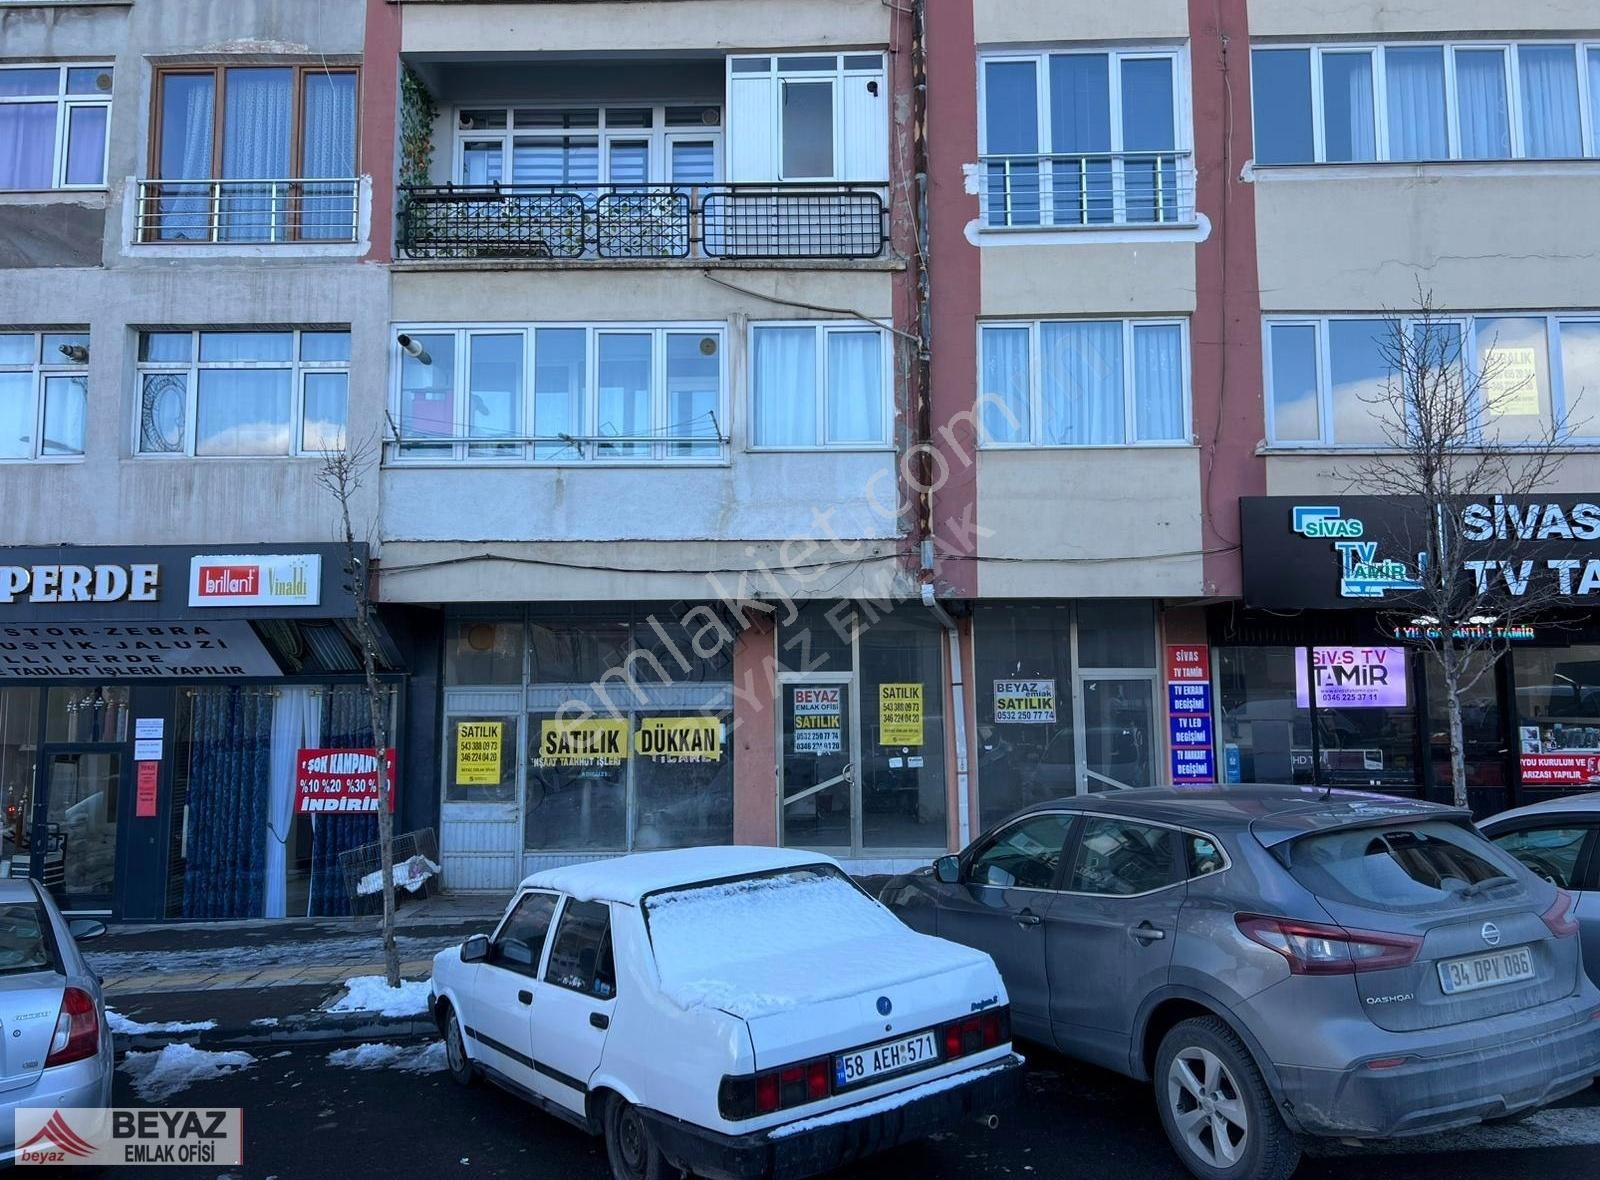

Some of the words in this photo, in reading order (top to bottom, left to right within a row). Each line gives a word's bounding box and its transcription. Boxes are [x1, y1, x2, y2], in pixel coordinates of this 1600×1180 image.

[1462, 494, 1600, 540] SİVAS
[1306, 519, 1361, 536] SİVAS
[0, 564, 158, 602] PERDE
[206, 569, 253, 593] brillant
[1463, 560, 1534, 595] TV
[1496, 625, 1535, 638] TAMİR
[63, 655, 164, 664] PERDE
[1176, 649, 1199, 661] SİVAS
[1361, 650, 1386, 663] TV
[9, 666, 91, 676] TADİLAT
[95, 666, 162, 677] İŞLERİ
[166, 666, 246, 675] YAPILIR
[1173, 667, 1182, 677] TV
[882, 687, 920, 699] SATILIK
[997, 683, 1038, 693] BEYAZ
[1174, 686, 1183, 696] TV
[796, 690, 839, 703] BEYAZ
[997, 698, 1053, 710] SATILIK
[998, 711, 1016, 719] 0532
[1018, 711, 1031, 719] 250
[1033, 711, 1043, 719] 77
[795, 716, 840, 728] SATILIK
[1178, 718, 1188, 728] TV
[1188, 718, 1202, 728] LED
[461, 726, 498, 738] SATILIK
[546, 729, 619, 755] SATILIK
[641, 724, 715, 753] DÜKKAN
[461, 741, 471, 750] 543
[491, 741, 497, 750] 73
[308, 755, 327, 773] ŞOK
[329, 753, 379, 774] KAMPANY
[1553, 771, 1581, 779] YAPILIR
[301, 779, 319, 793] %10
[322, 779, 341, 793] %20
[347, 779, 366, 793] %30
[1450, 963, 1470, 987] 34
[1474, 957, 1500, 982] DPY
[1504, 952, 1530, 977] 086
[1366, 993, 1414, 1005] QASHQAI
[845, 1055, 865, 1079] 58
[873, 1045, 901, 1072] AEH
[907, 1036, 933, 1061] 571
